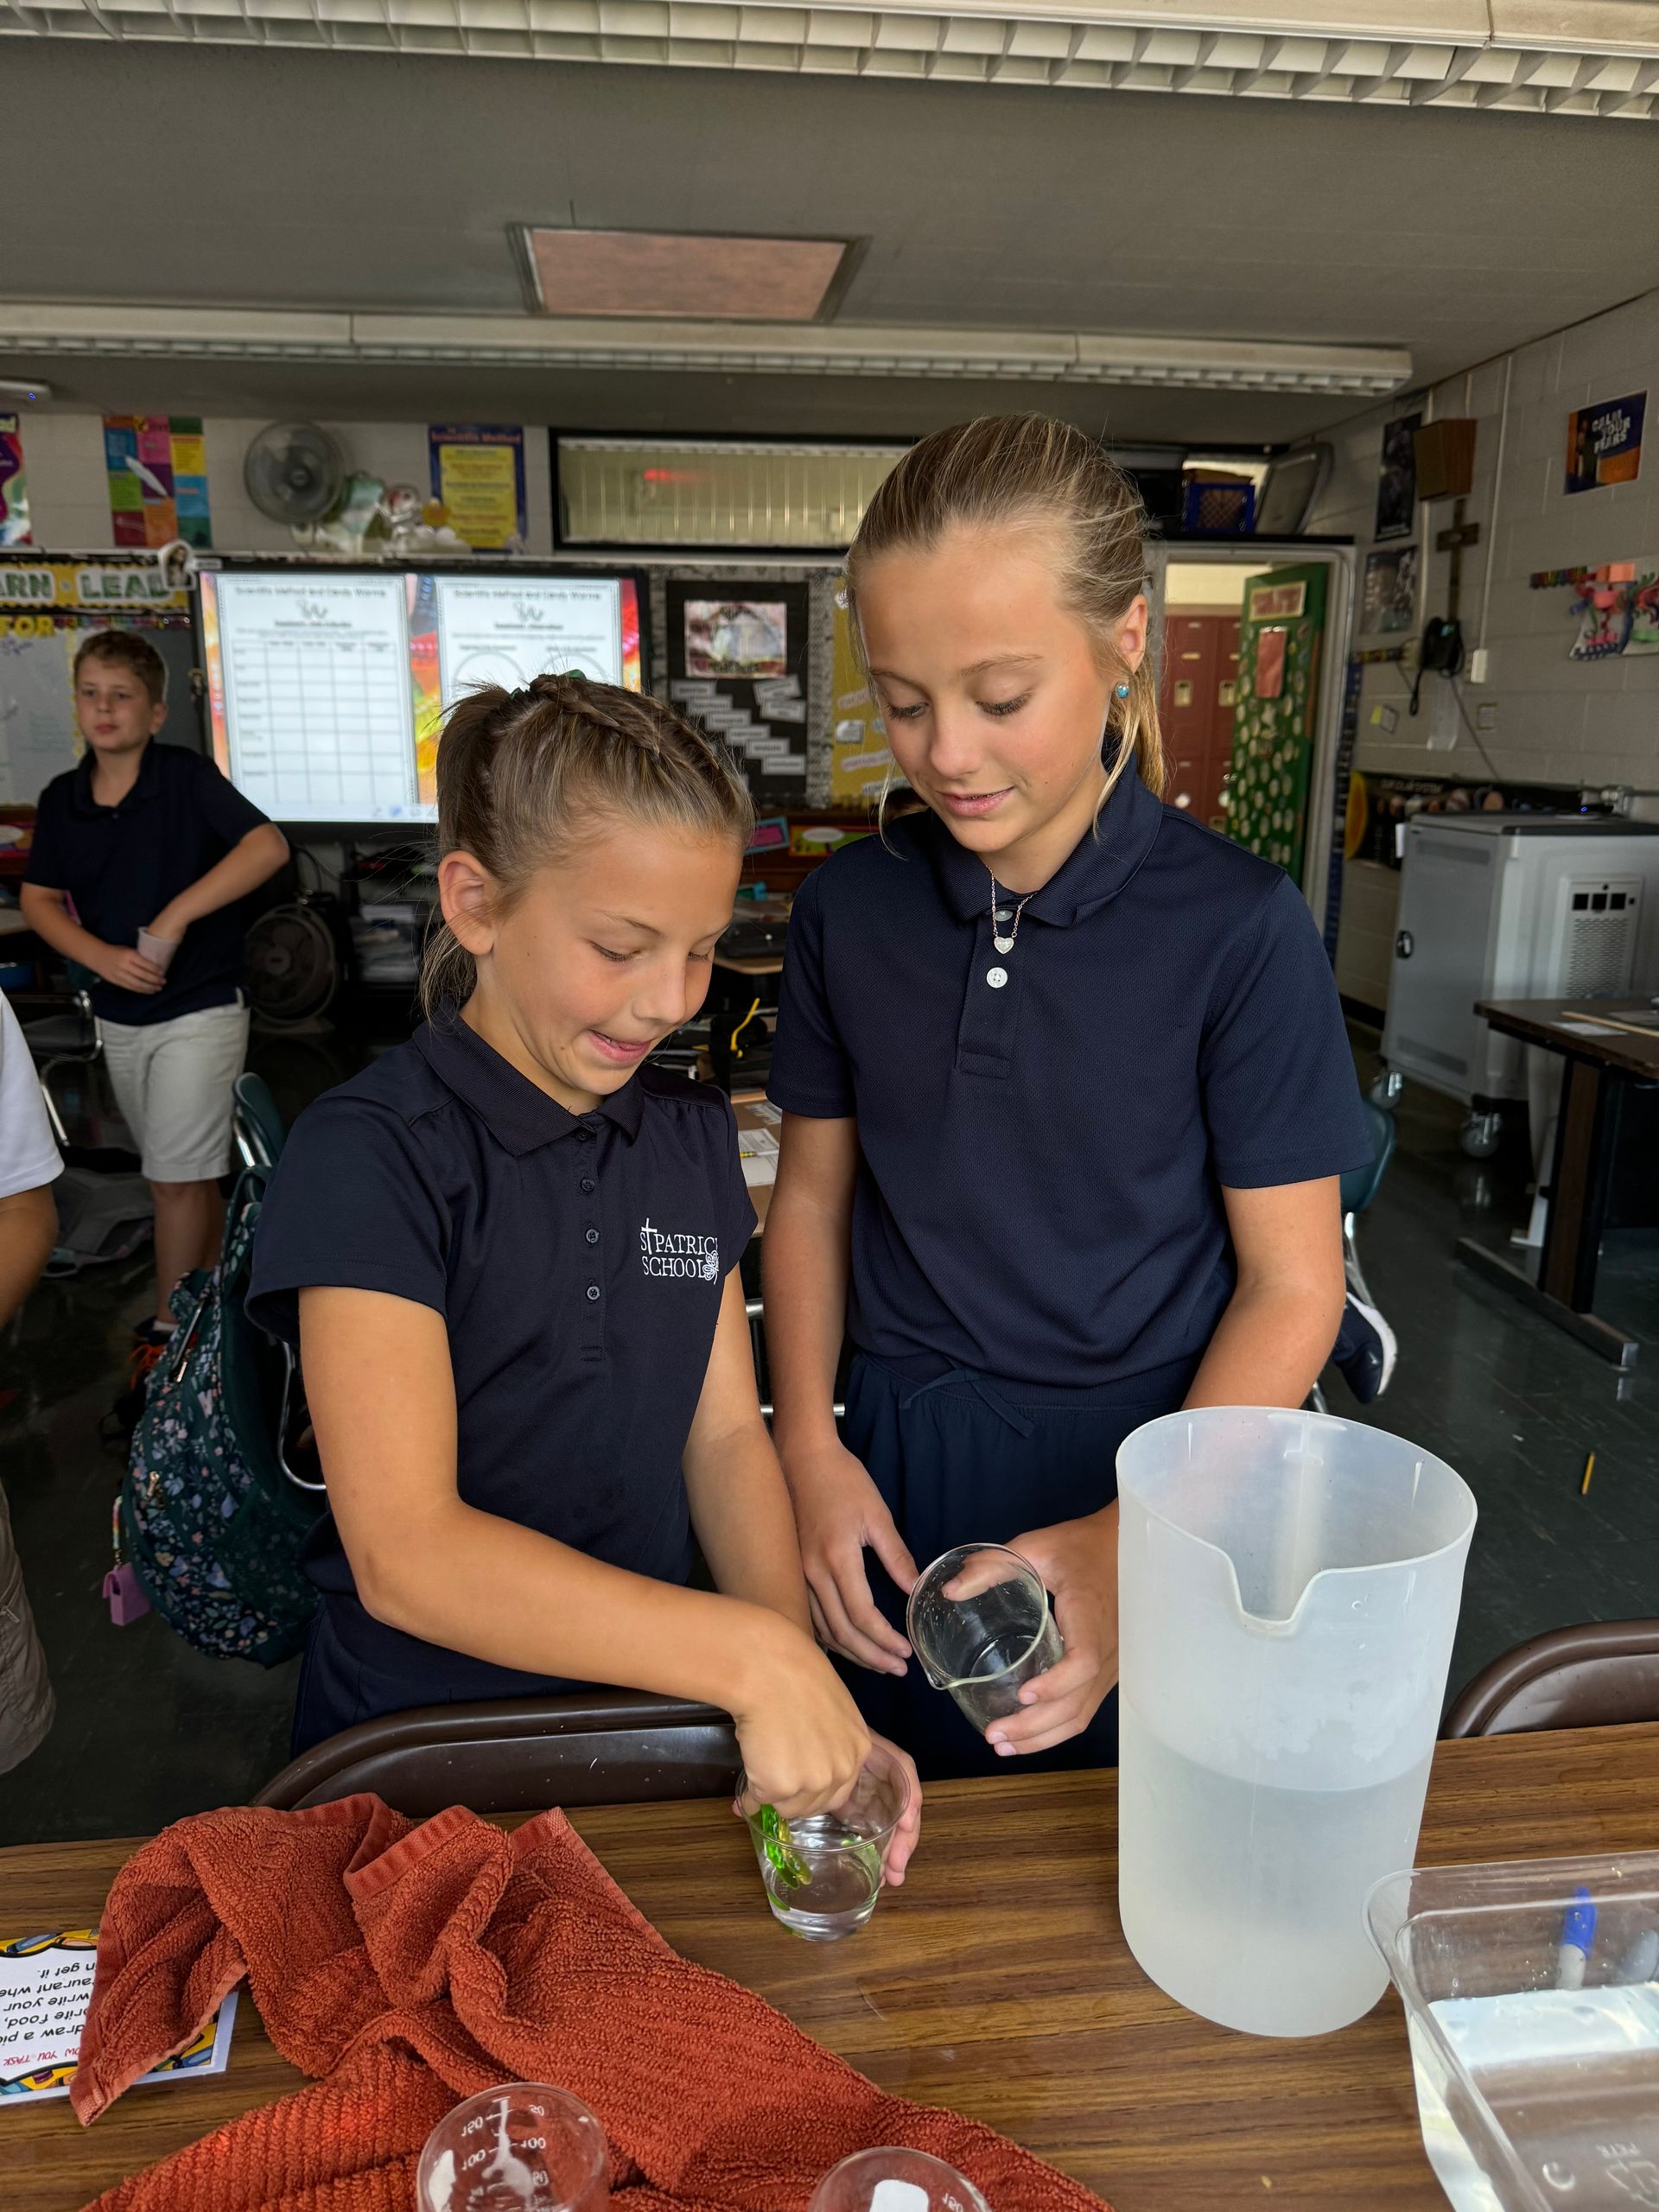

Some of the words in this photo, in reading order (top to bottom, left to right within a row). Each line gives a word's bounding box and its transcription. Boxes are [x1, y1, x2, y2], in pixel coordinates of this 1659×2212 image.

[653, 1233, 718, 1255] PATRIC
[642, 1255, 705, 1279] SCHOOL
[37, 1969, 50, 1979] it.
[54, 1962, 79, 1976] get
[36, 1978, 94, 1993] aurant
[3, 1997, 43, 2012] your
[48, 1993, 89, 2005] write
[4, 2013, 48, 2029] food,
[23, 2031, 35, 2041] a
[41, 2024, 85, 2037] draw
[3, 2055, 30, 2067] TASK
[37, 2050, 58, 2062] YOU
